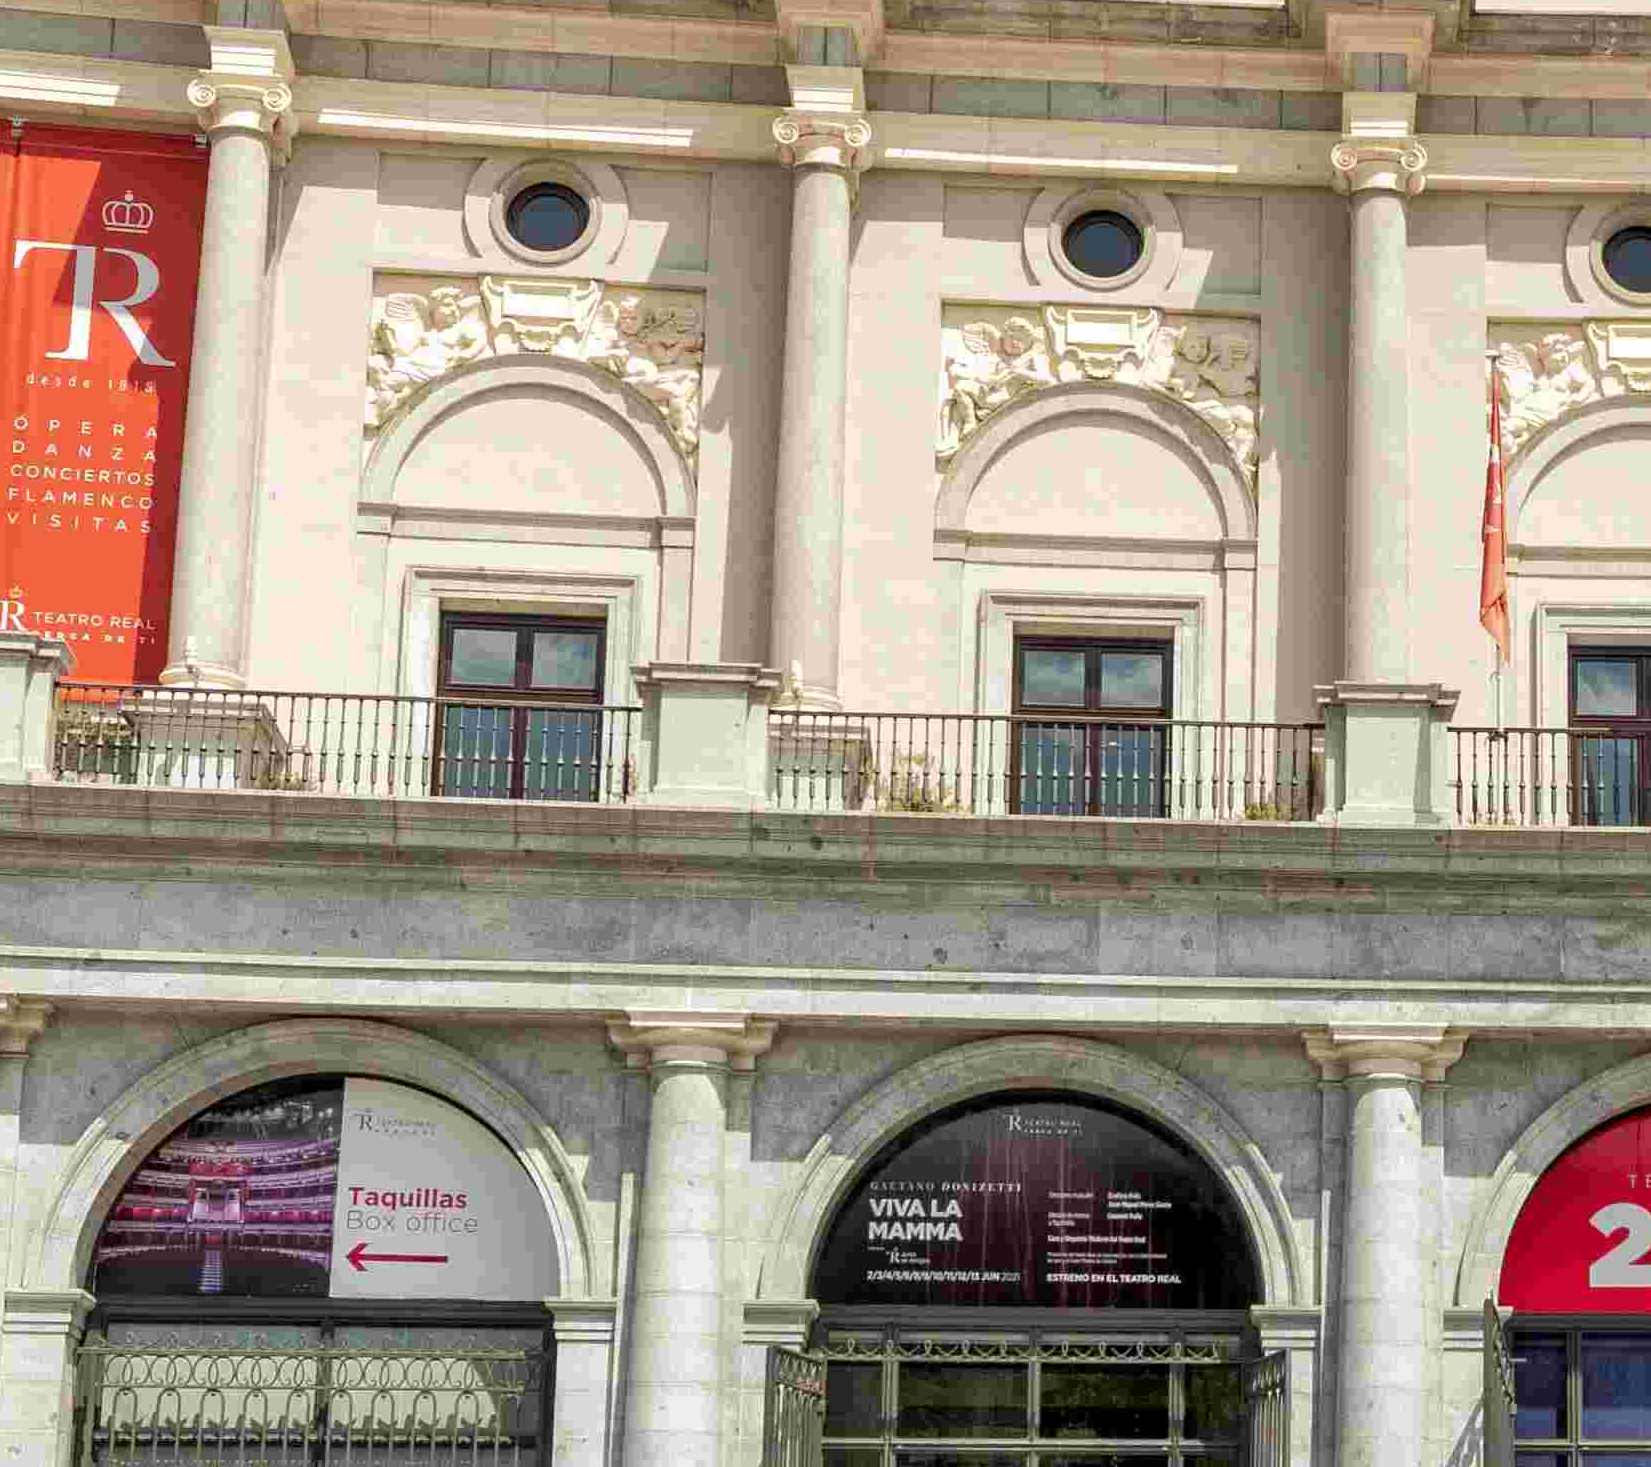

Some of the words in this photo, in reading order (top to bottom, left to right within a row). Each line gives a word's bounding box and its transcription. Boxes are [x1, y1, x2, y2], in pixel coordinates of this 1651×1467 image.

[24, 372, 92, 388] desde
[13, 415, 157, 438] ÓPERA
[12, 440, 156, 462] DANZA
[11, 464, 155, 486] CONCIERTOS
[8, 488, 152, 510] FLAMENCO
[7, 512, 150, 533] VISITAS
[32, 612, 103, 627] TEATRO
[109, 616, 156, 630] REAL
[349, 1187, 468, 1209] Taquillas
[869, 1198, 926, 1218] VIVA
[930, 1199, 963, 1218] LA
[346, 1210, 396, 1230] Box
[406, 1211, 478, 1232] office
[868, 1221, 964, 1241] MAMMA
[1047, 1273, 1089, 1282] ESTRENO
[1092, 1273, 1104, 1282] EN
[1106, 1273, 1118, 1282] EL
[1119, 1274, 1156, 1283] TEATRO
[1157, 1274, 1181, 1284] REAL
